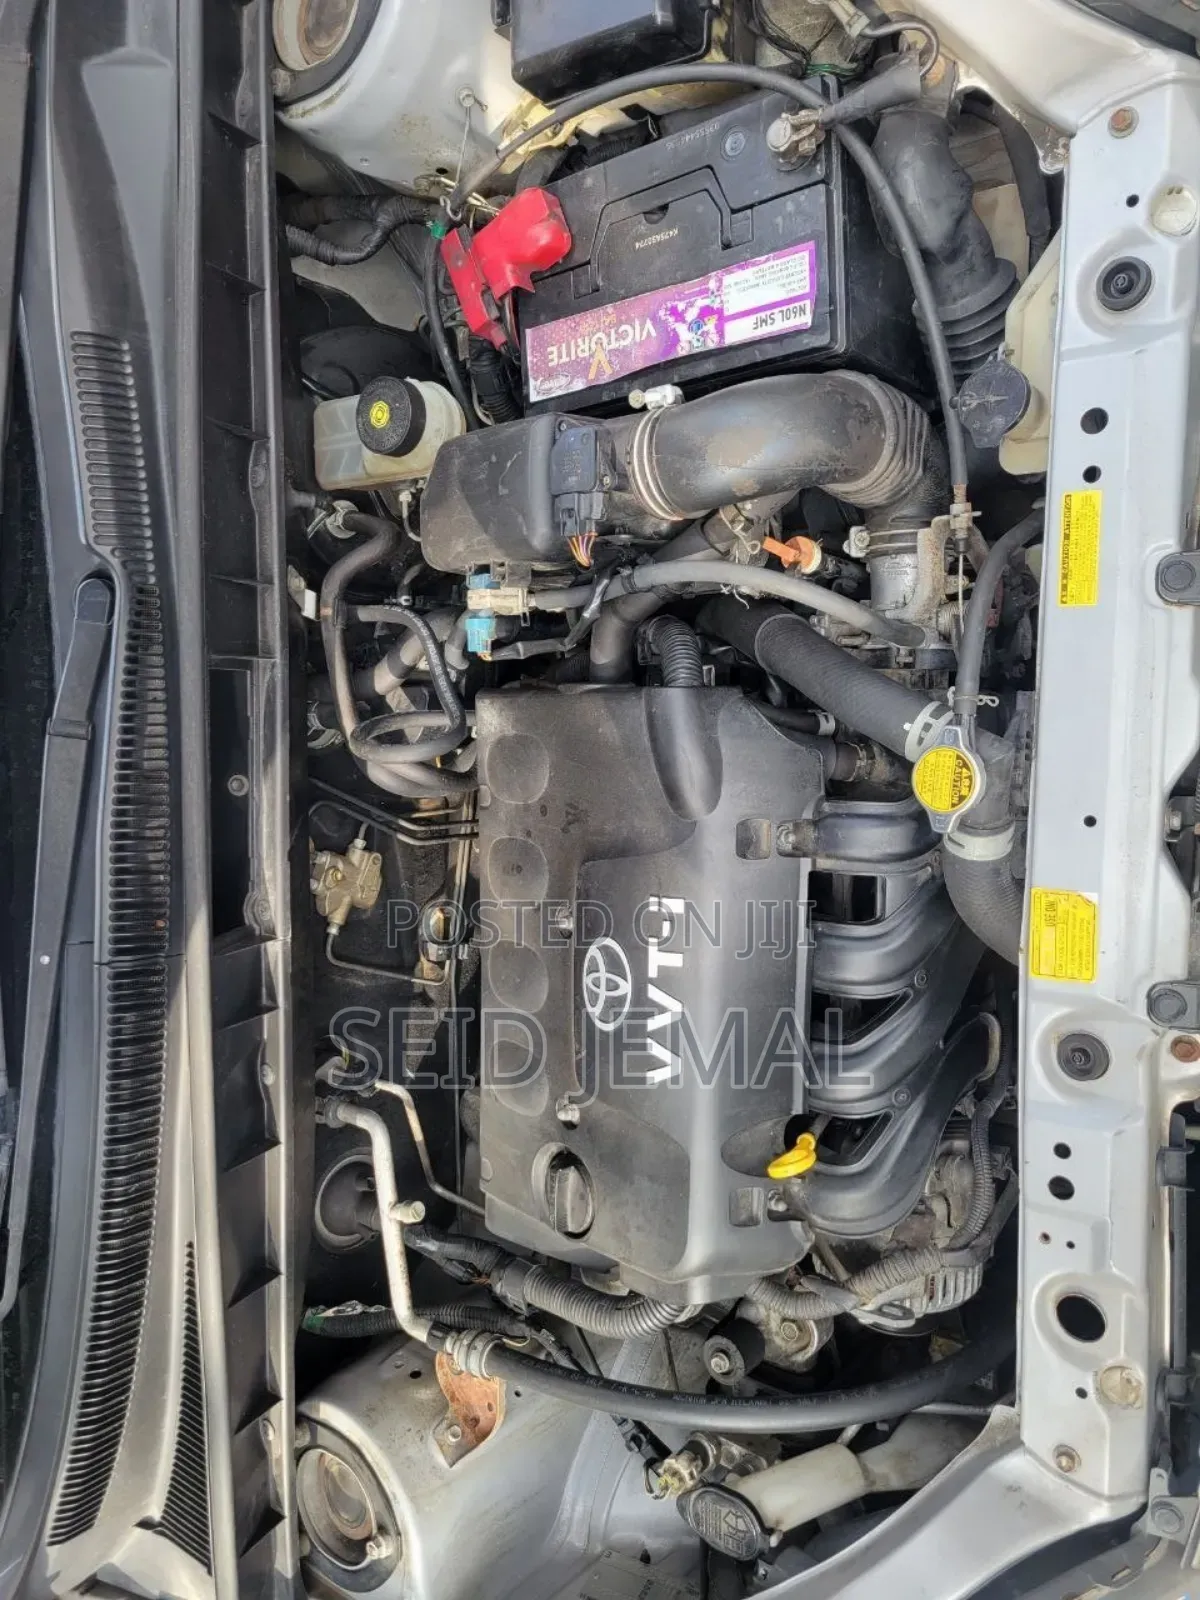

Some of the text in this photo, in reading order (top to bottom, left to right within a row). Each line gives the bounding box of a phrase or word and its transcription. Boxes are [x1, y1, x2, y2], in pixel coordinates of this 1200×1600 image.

[752, 303, 806, 330] N60L SMF
[952, 759, 963, 804] CAUTION
